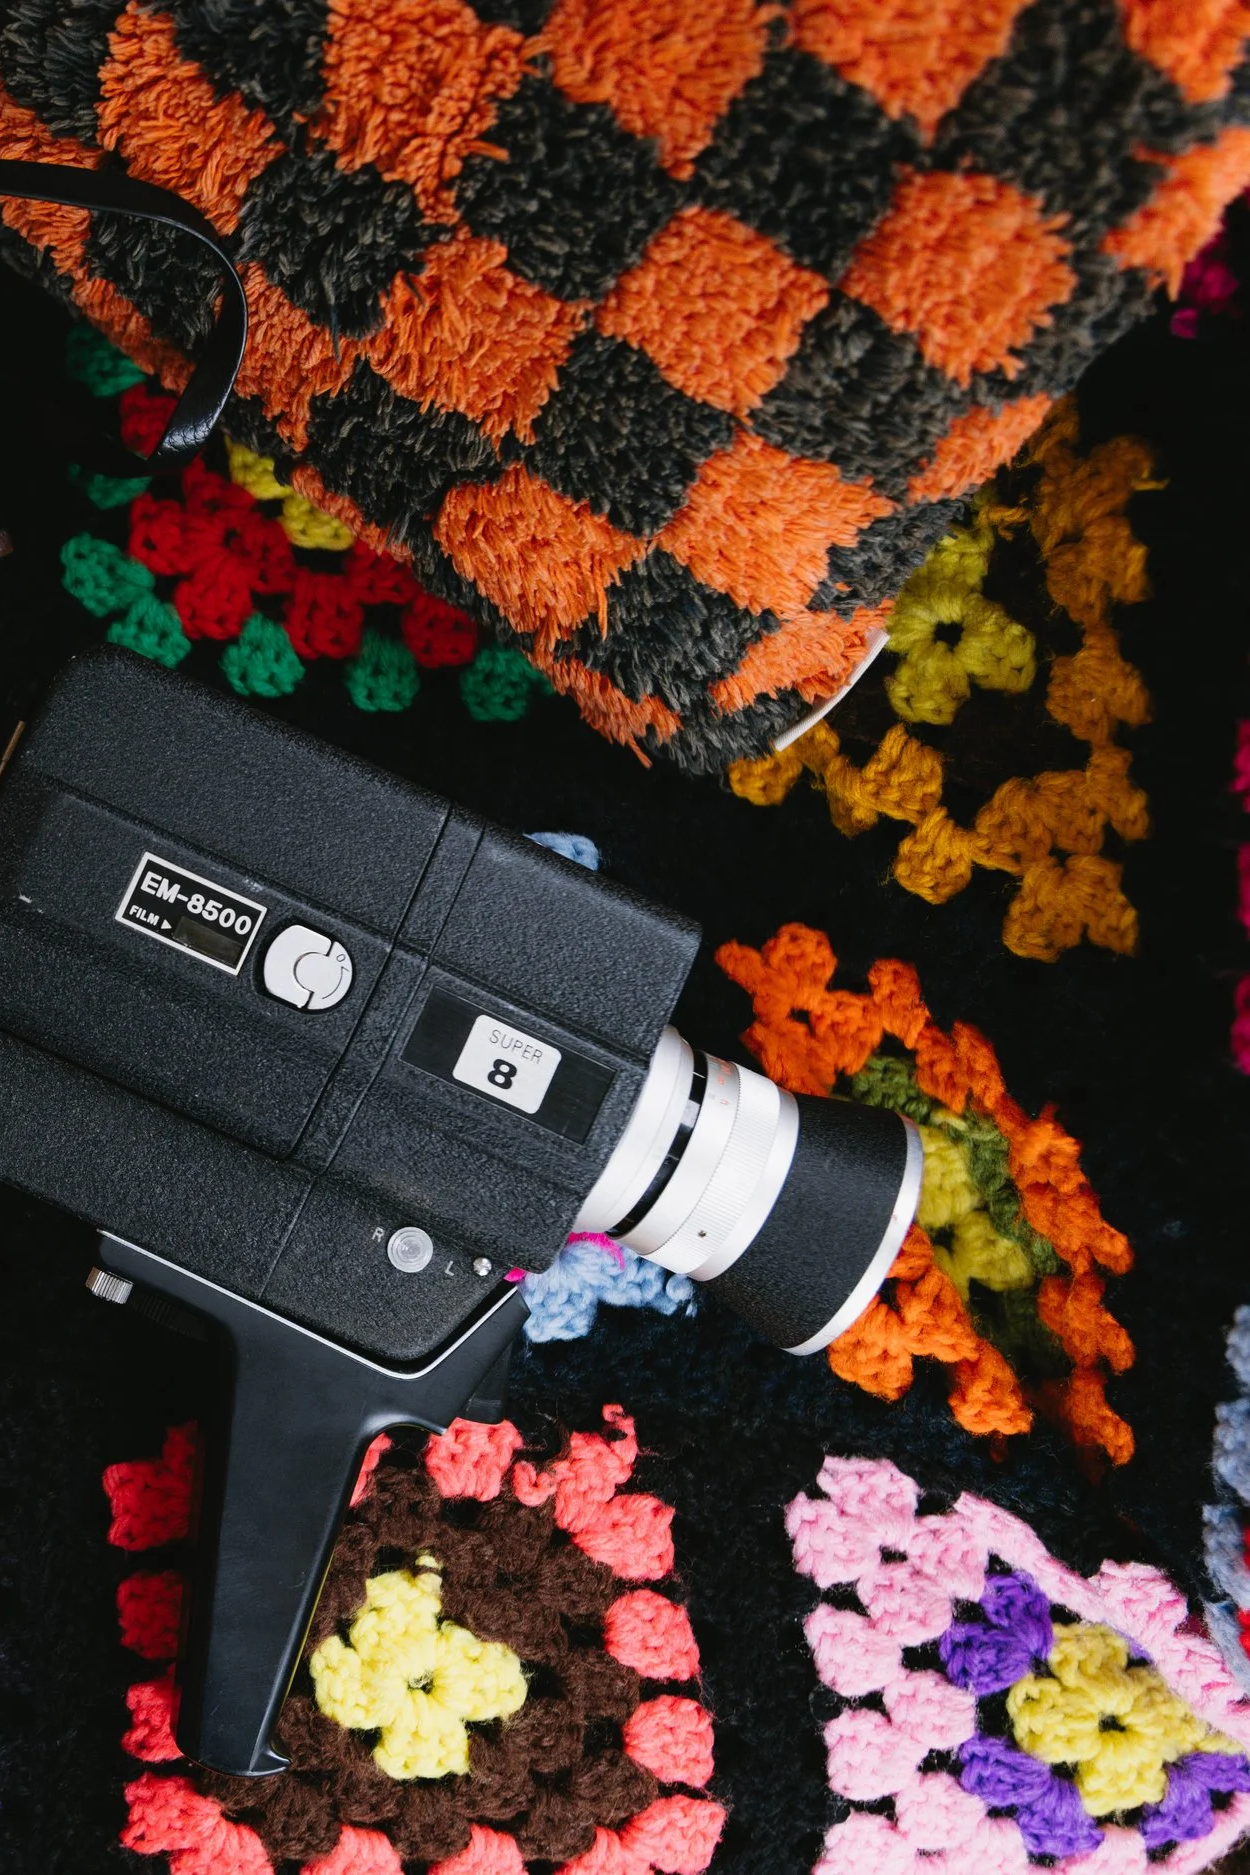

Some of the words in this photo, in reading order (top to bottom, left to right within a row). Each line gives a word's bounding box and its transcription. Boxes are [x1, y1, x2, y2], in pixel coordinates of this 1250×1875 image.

[128, 904, 160, 928] FILM
[140, 870, 252, 936] EM-8500
[488, 1028, 544, 1065] SUPER
[486, 1058, 518, 1090] 8
[371, 1226, 386, 1243] R
[444, 1260, 455, 1277] L
